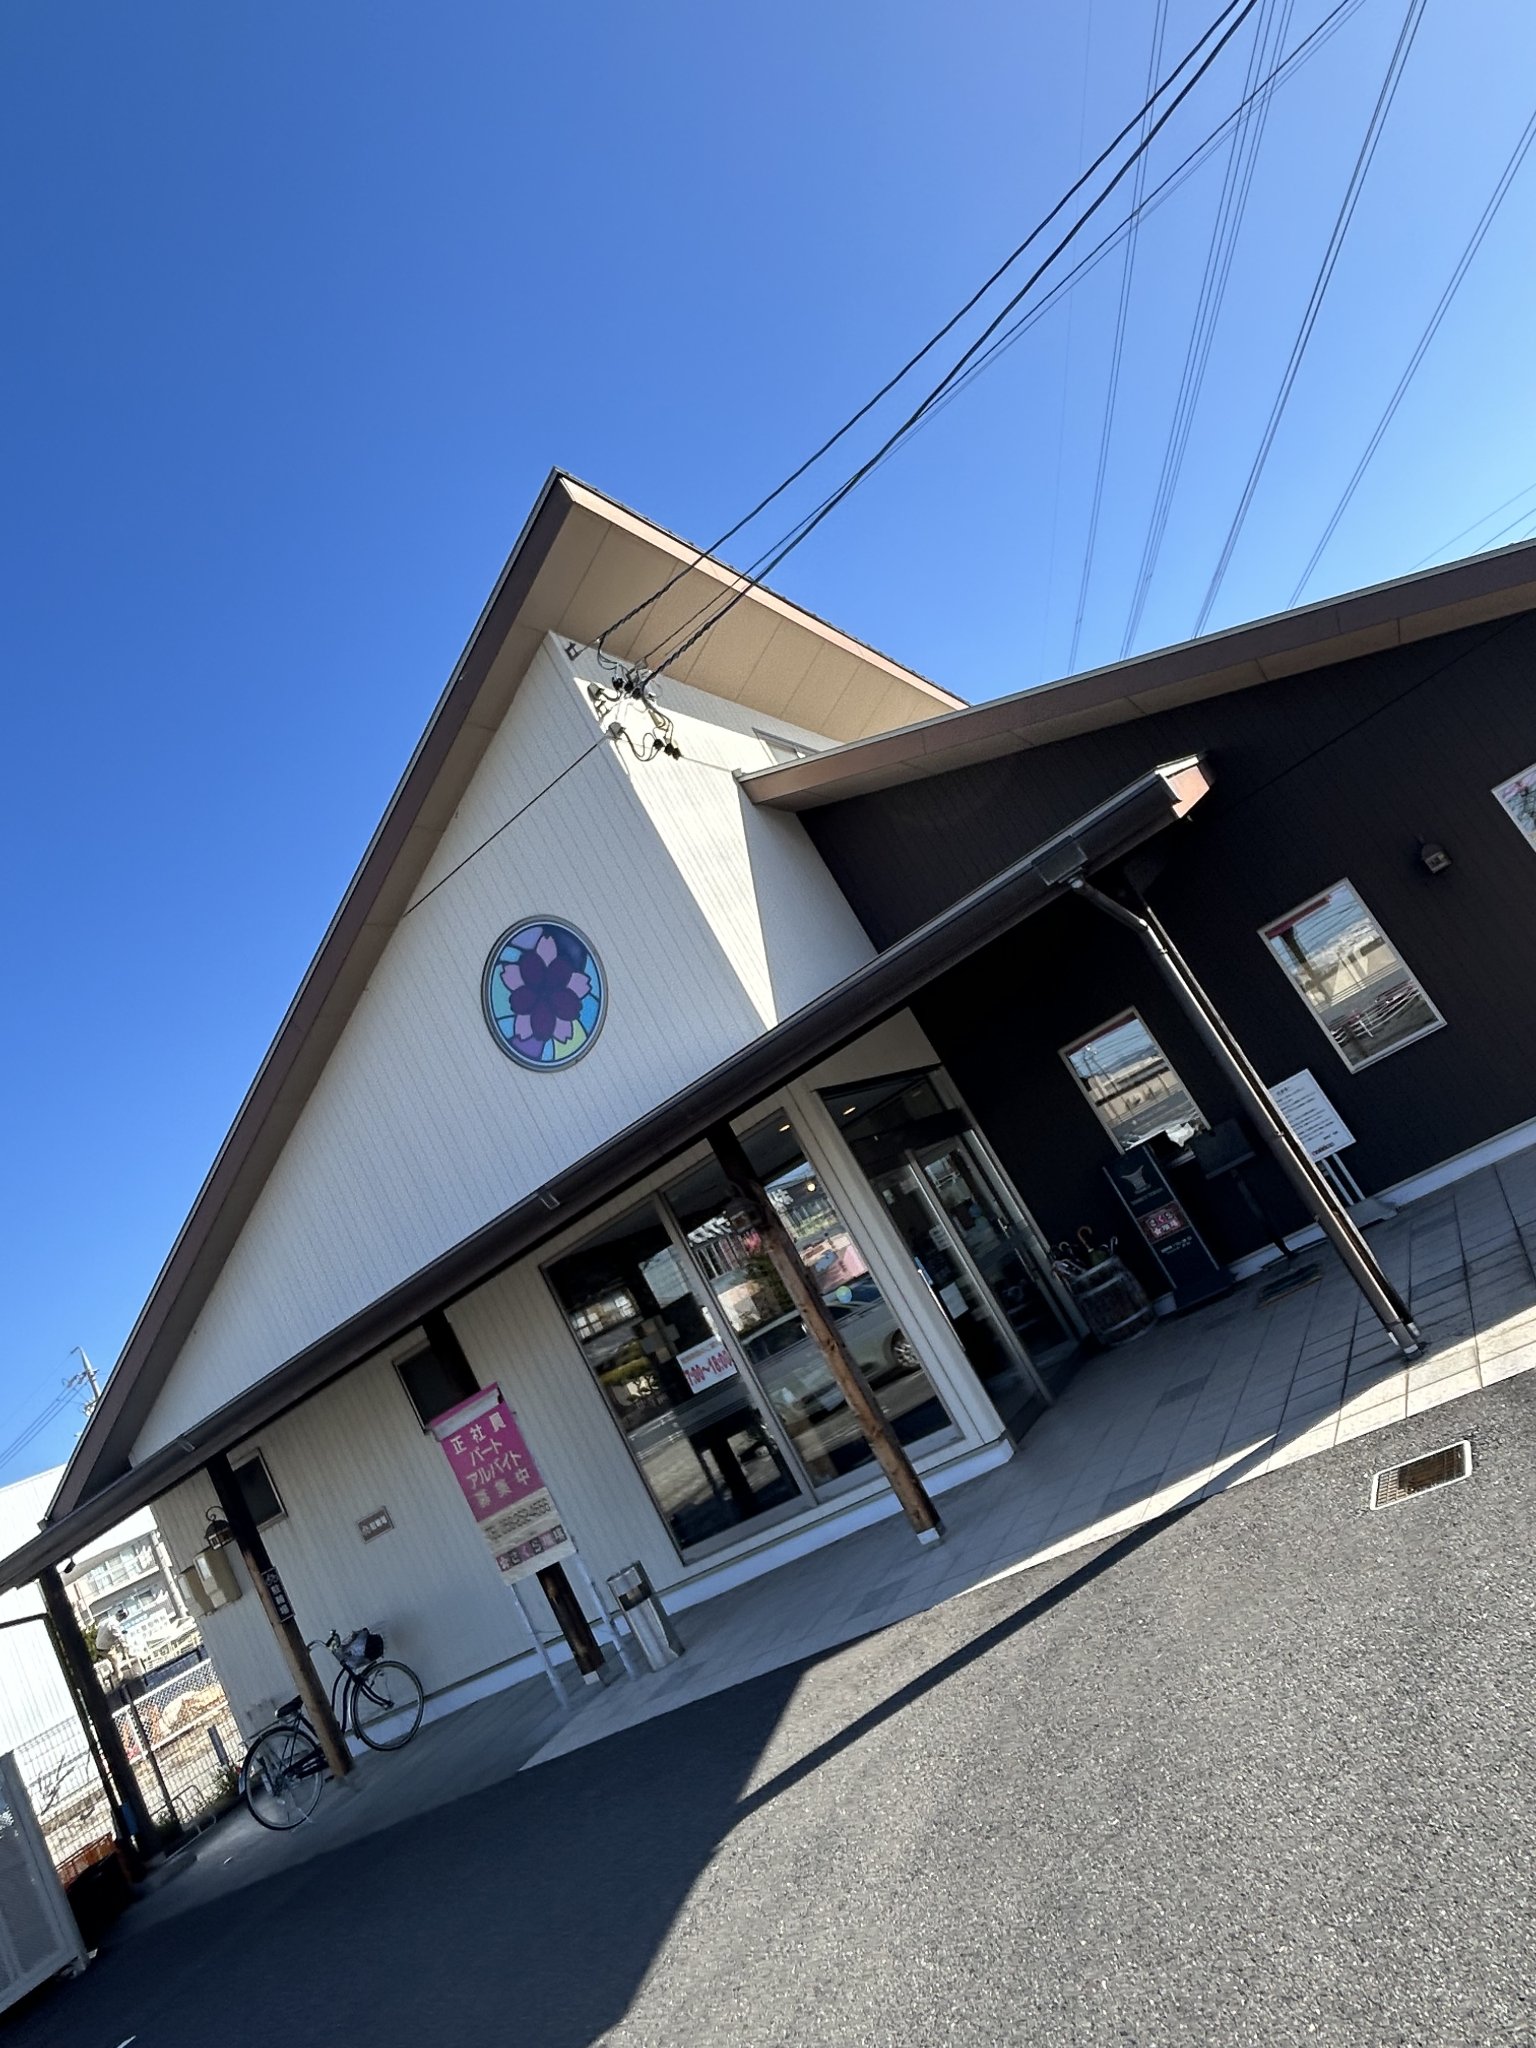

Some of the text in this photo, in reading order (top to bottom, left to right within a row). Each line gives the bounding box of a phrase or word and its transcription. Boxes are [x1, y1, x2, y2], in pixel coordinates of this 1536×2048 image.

[449, 1411, 507, 1455] 正社員
[470, 1438, 502, 1467] パート
[466, 1450, 521, 1490] アルバイト
